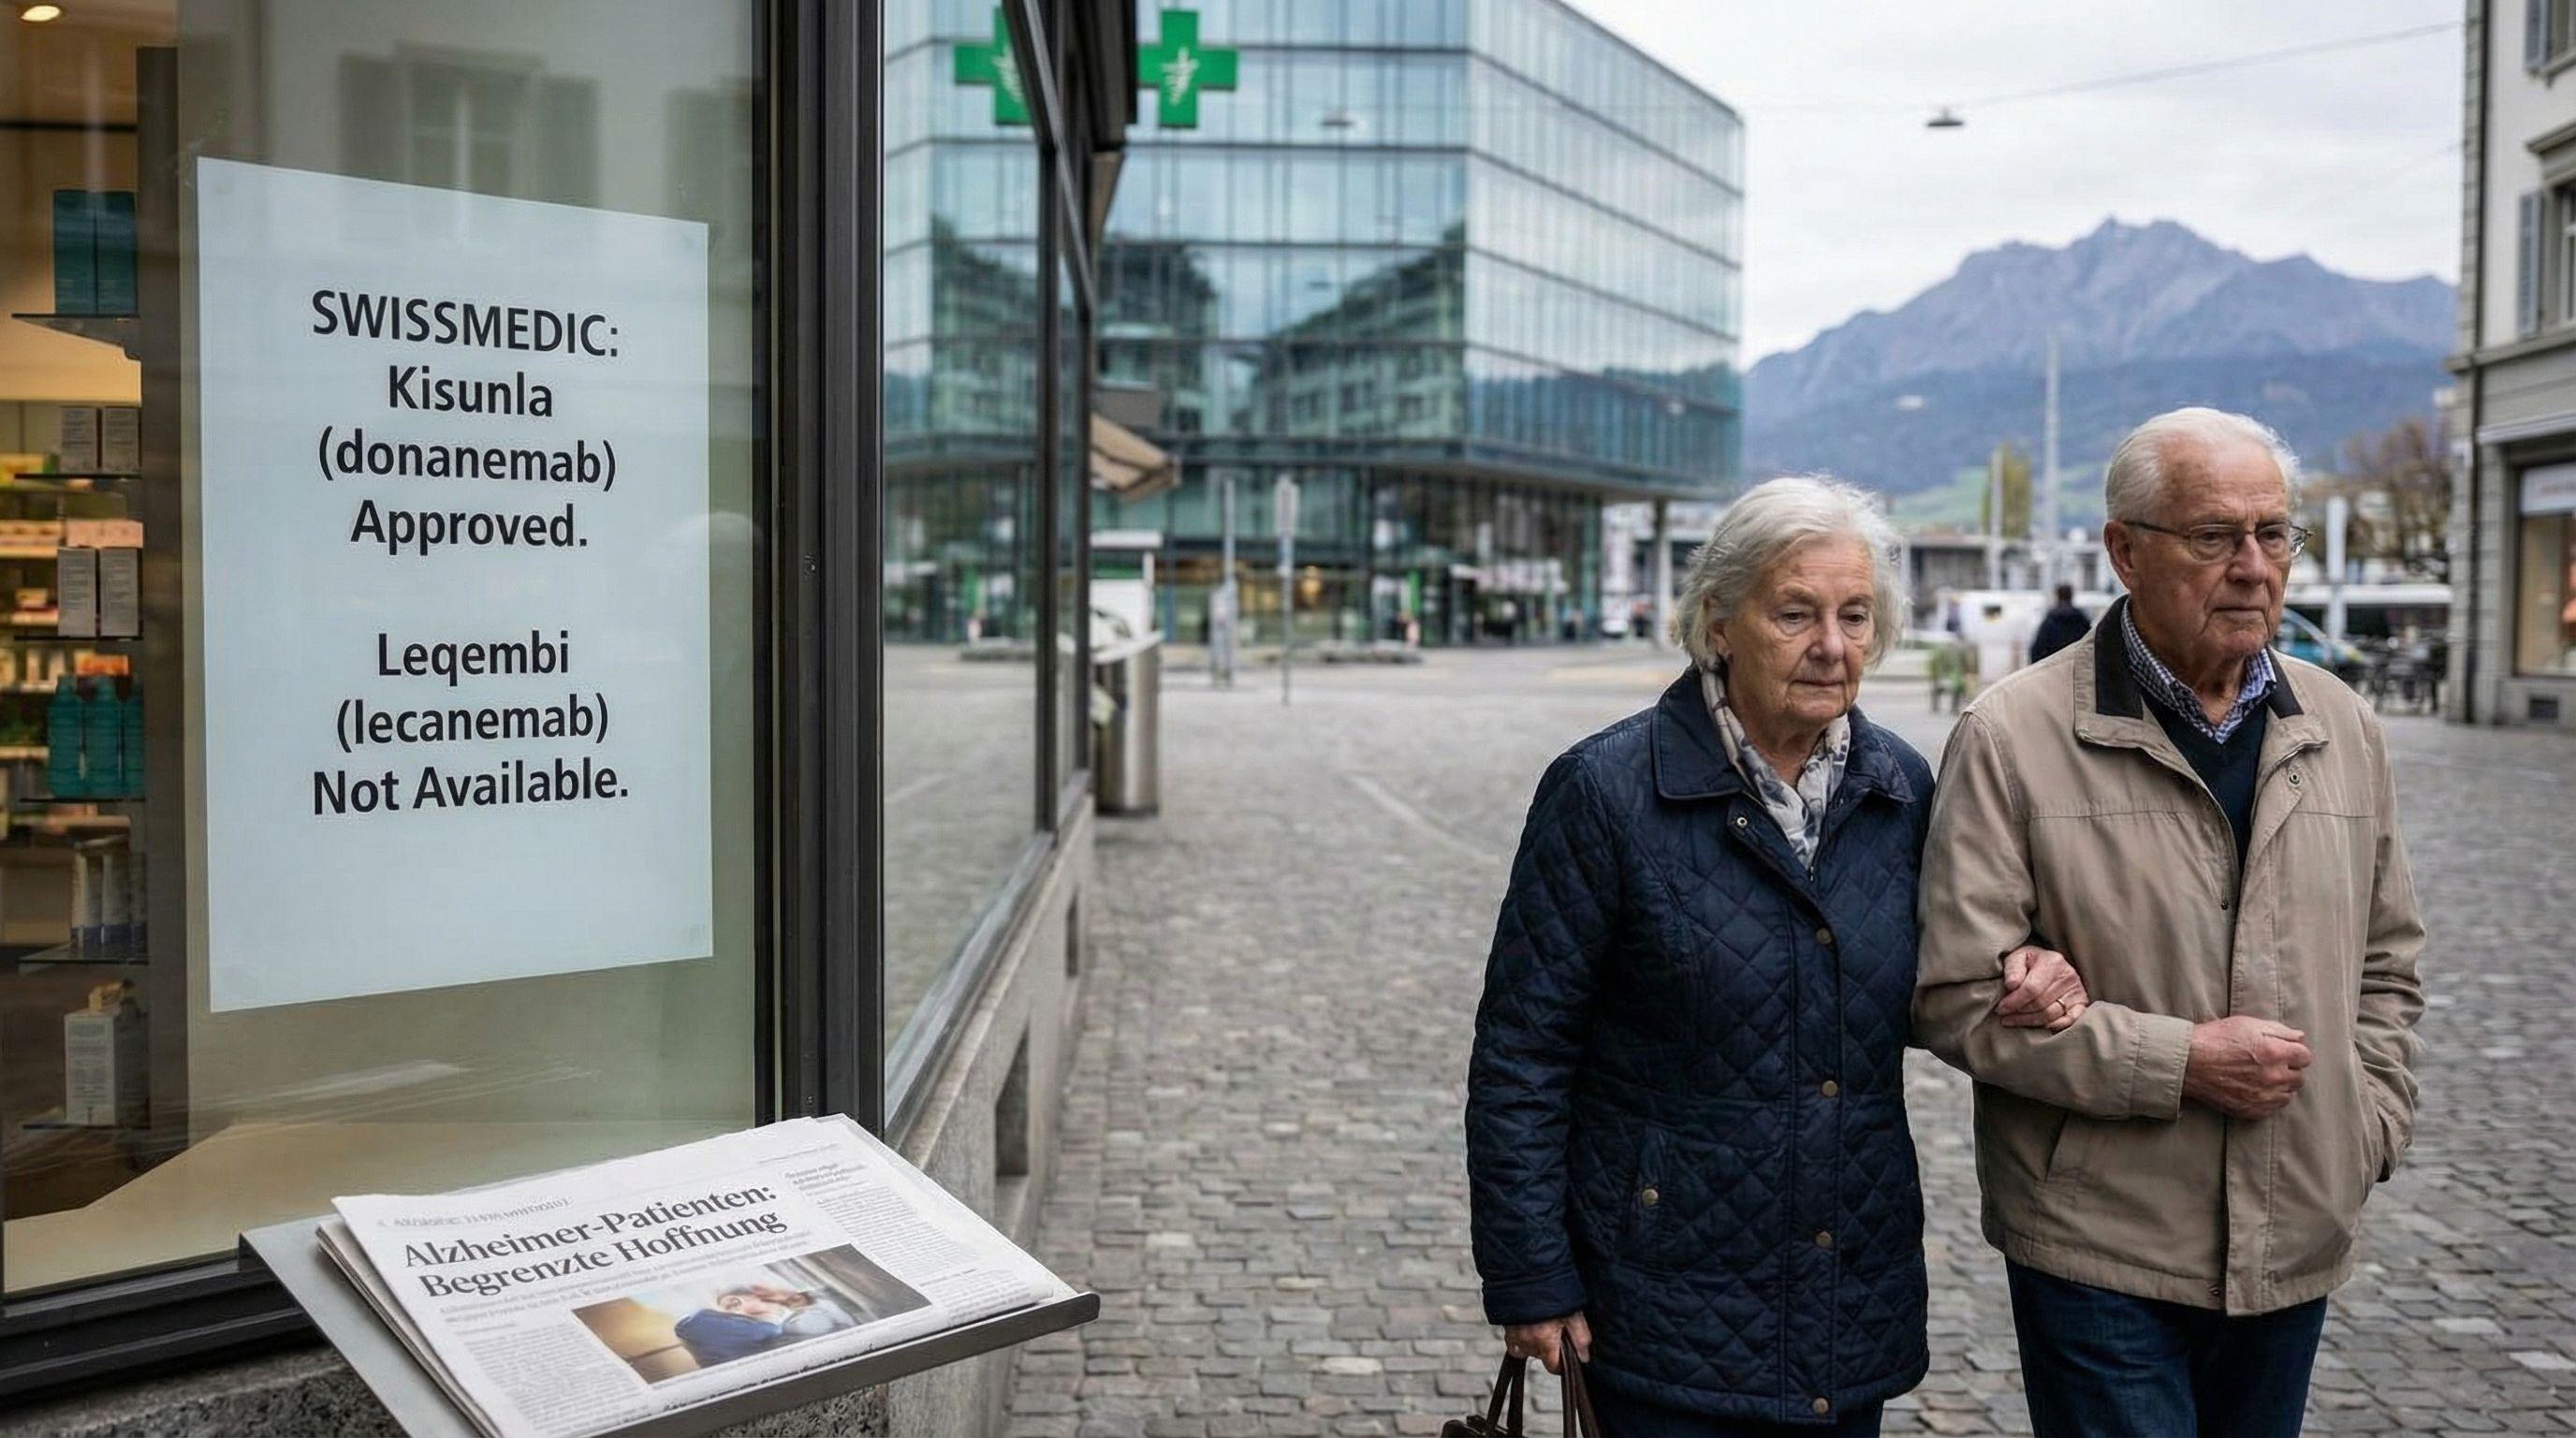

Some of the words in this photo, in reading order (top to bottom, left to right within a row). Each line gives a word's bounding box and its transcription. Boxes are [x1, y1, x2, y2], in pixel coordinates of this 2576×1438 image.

[311, 288, 619, 359] SWISSMEDIC:
[388, 363, 554, 418] Kisunla
[317, 425, 617, 492] (donanemab)
[349, 498, 590, 557] Approved.
[377, 631, 570, 688] Leqembi
[336, 691, 610, 755] (lecanemab)
[313, 769, 401, 816] Not
[412, 756, 630, 811] Available.
[403, 1183, 778, 1269] Alzheimer-Patienten:
[417, 1245, 613, 1298] Begrenzte
[612, 1209, 789, 1264] Hoffnung
